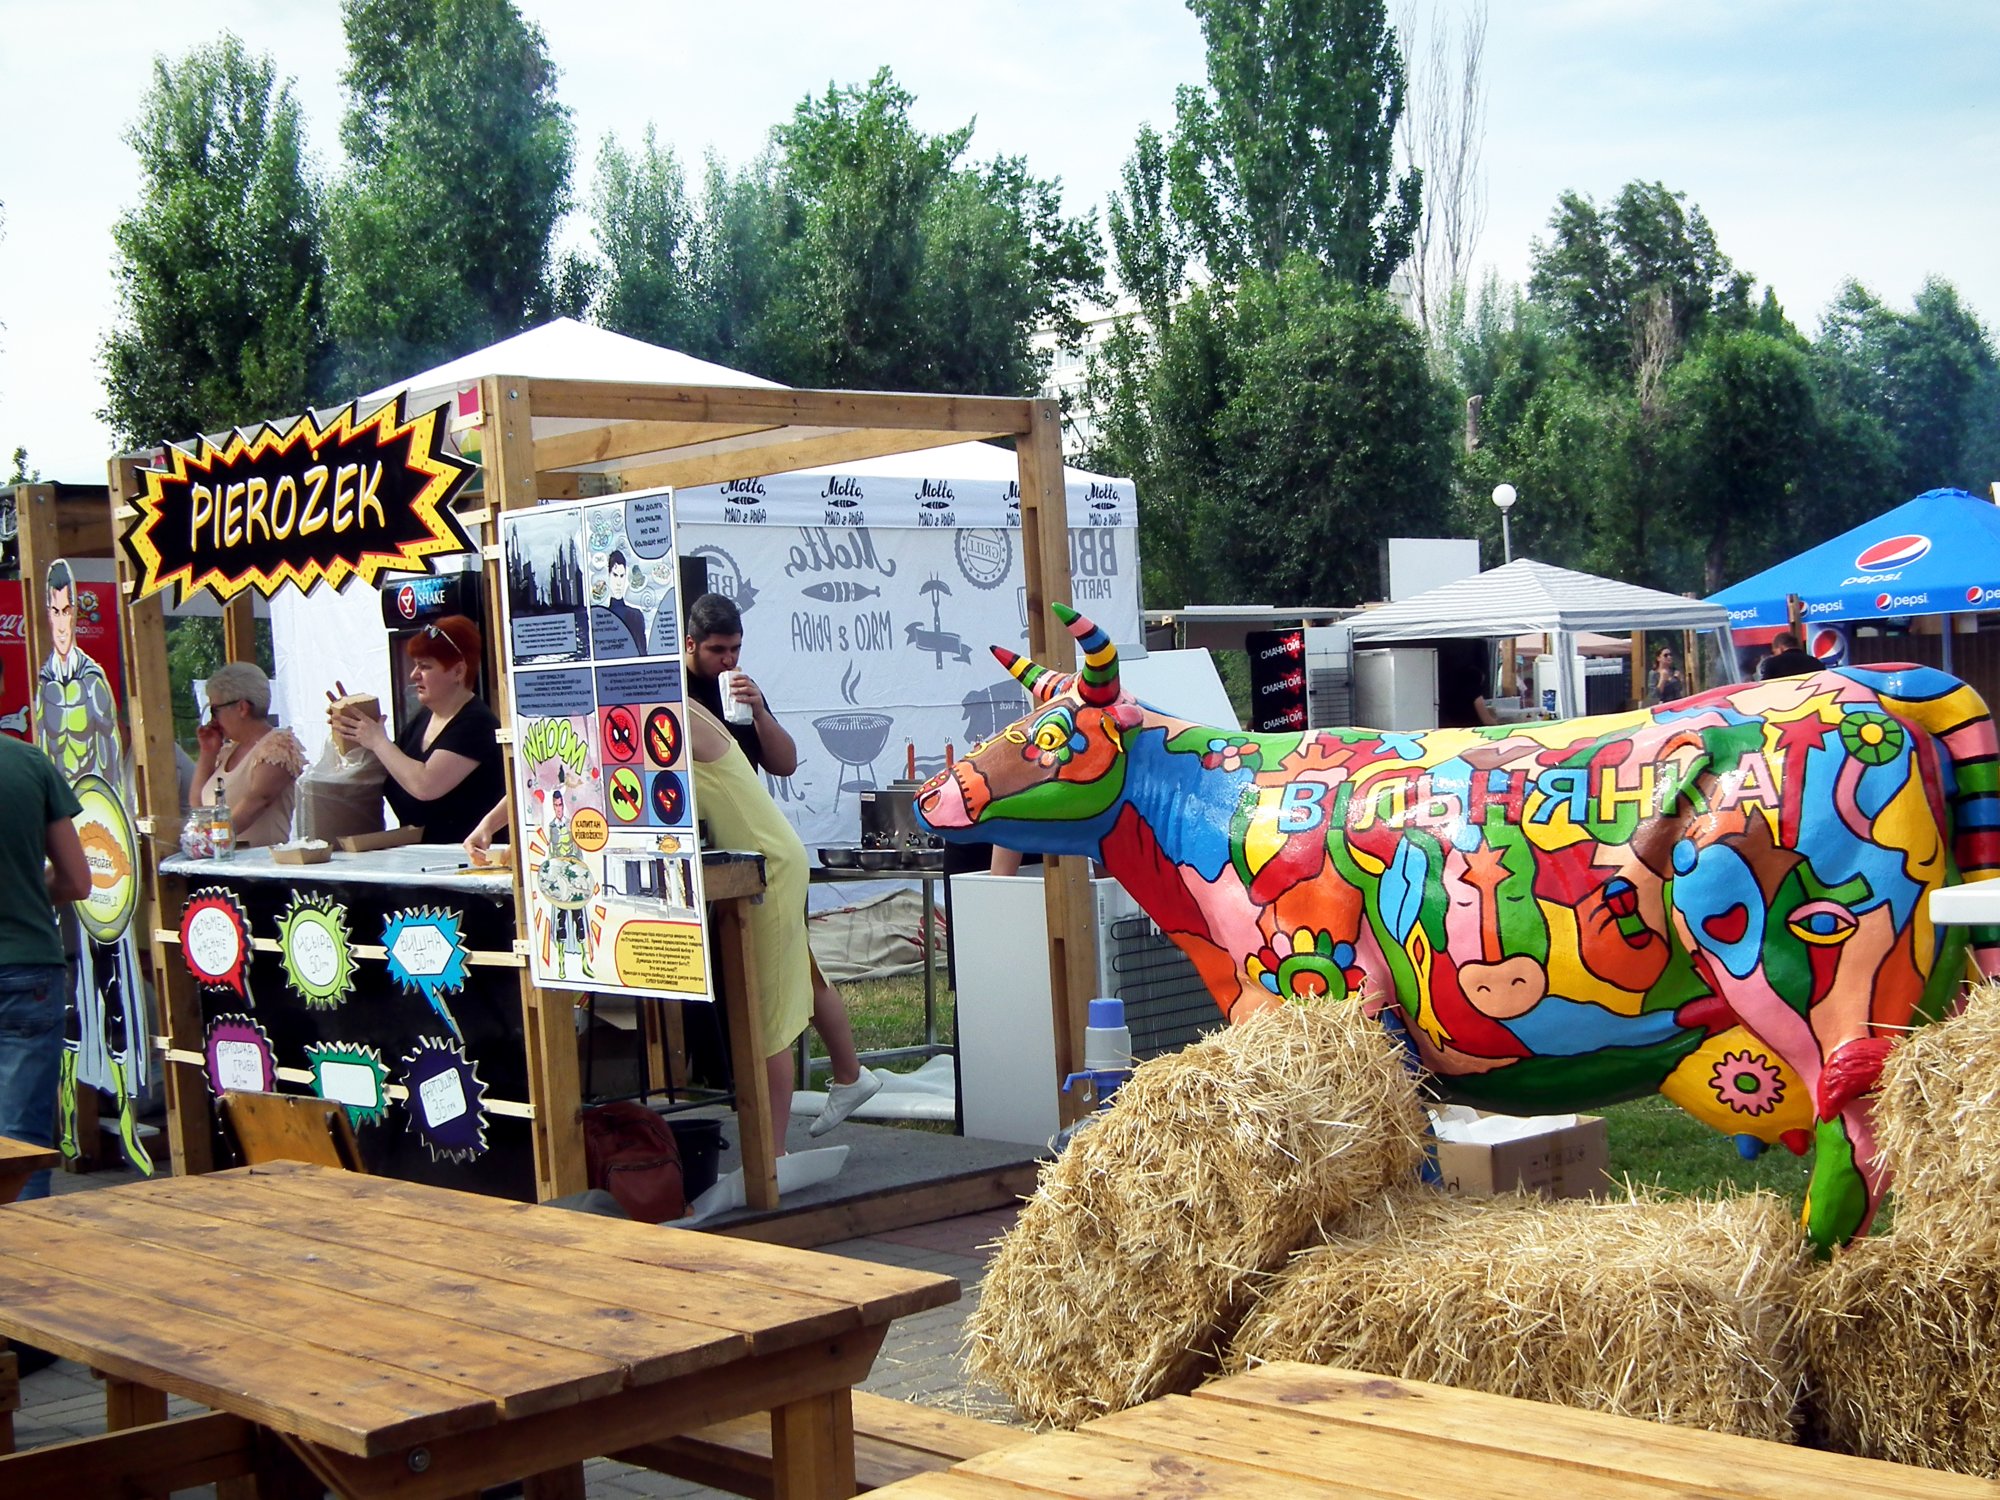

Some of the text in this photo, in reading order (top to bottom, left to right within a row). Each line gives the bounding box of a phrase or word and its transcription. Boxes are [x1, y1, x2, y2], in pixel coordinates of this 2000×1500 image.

[821, 476, 864, 499] Molto,
[914, 478, 955, 500] Molto,
[1085, 482, 1121, 502] Molto,
[190, 450, 386, 553] PIEROŻEK
[634, 502, 663, 513] Мы долго
[640, 528, 648, 536] но
[1840, 572, 1902, 587] pepsi
[418, 590, 446, 606] SHAKE
[1810, 599, 1844, 614] pepsi
[1893, 592, 1928, 608] pepsi
[523, 717, 588, 777] WHOOM
[400, 931, 441, 952] ВИШНЯ
